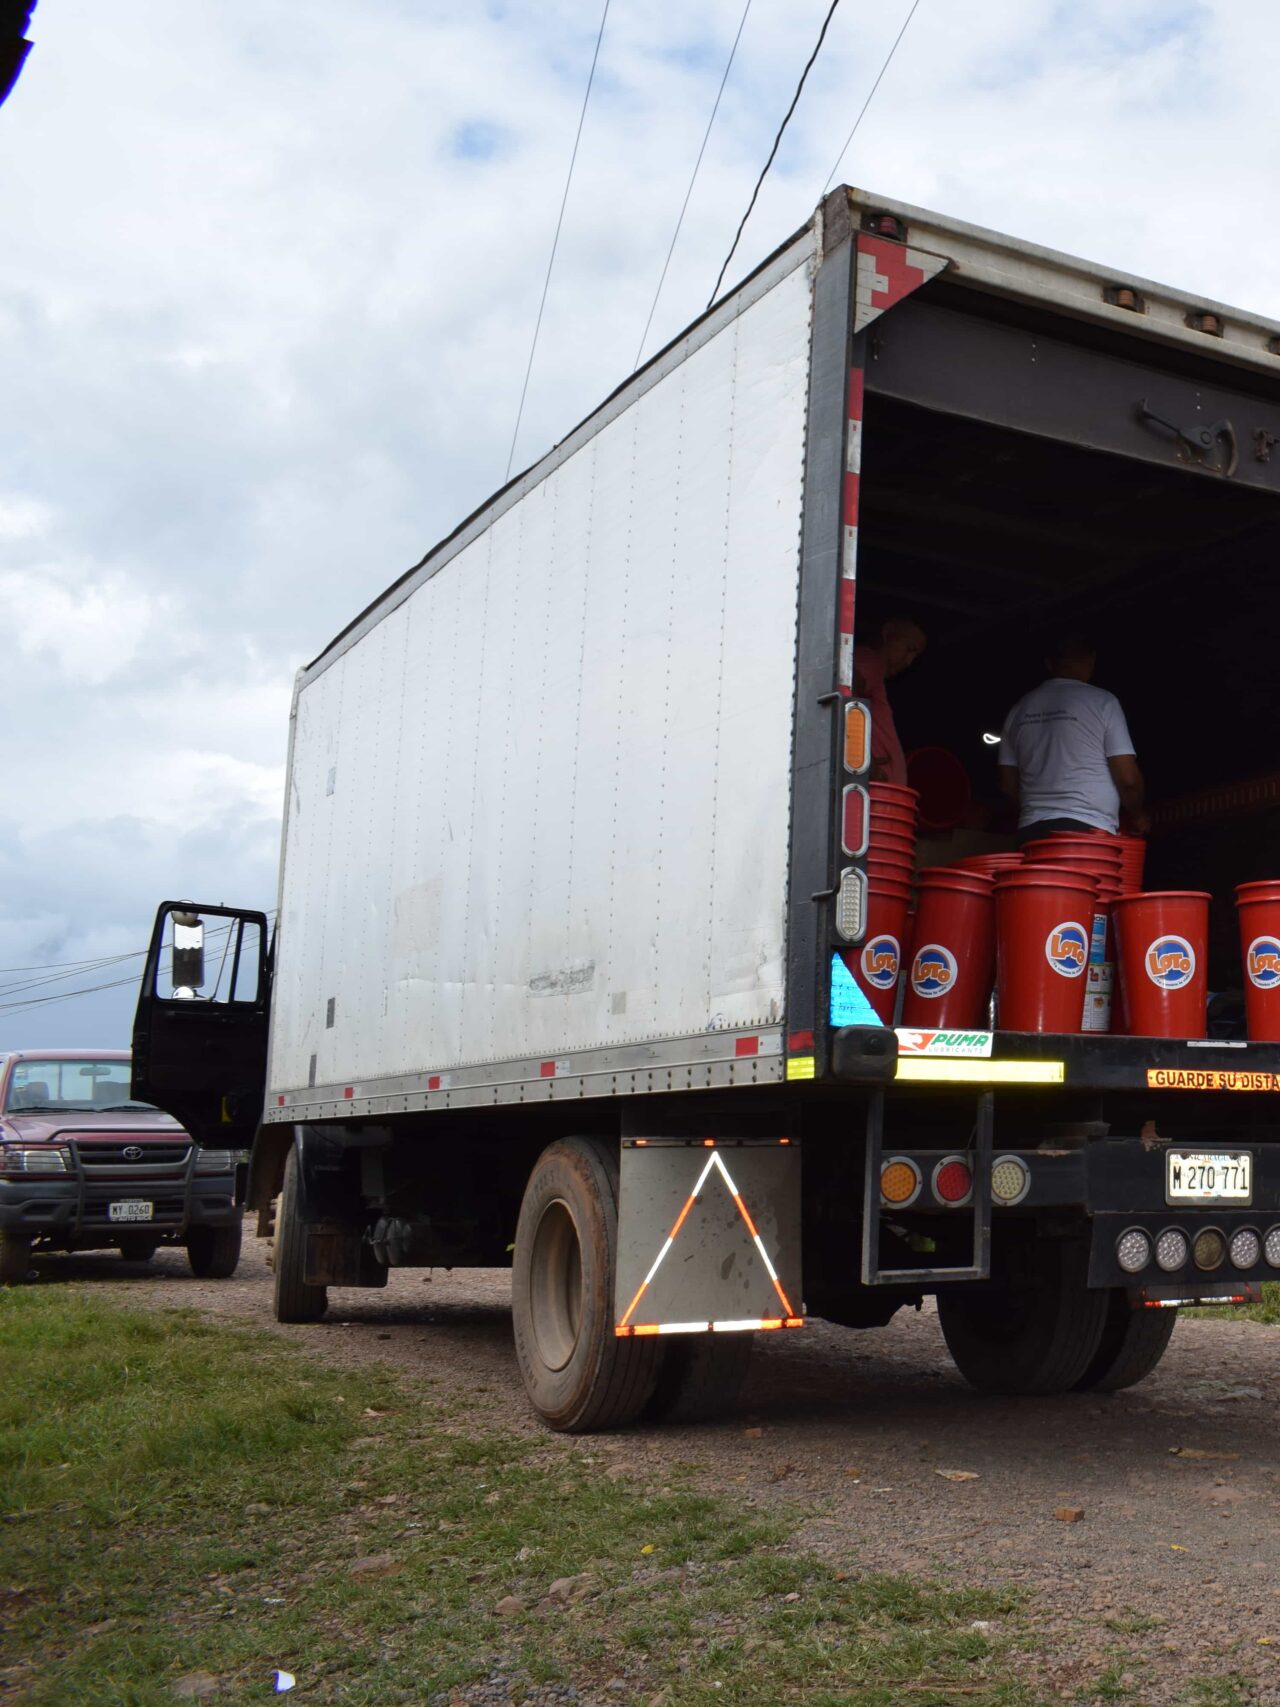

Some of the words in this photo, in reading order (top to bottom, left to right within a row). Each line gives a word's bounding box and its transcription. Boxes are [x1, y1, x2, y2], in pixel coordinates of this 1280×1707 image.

[930, 1033, 989, 1047] PUMA
[928, 1046, 983, 1054] LUBRICANTS
[1155, 1071, 1214, 1088] GUARDE
[1219, 1072, 1236, 1088] SU
[1173, 1165, 1182, 1190] M
[1187, 1165, 1215, 1190] 270
[1221, 1165, 1248, 1190] 771
[128, 1204, 150, 1215] 0260
